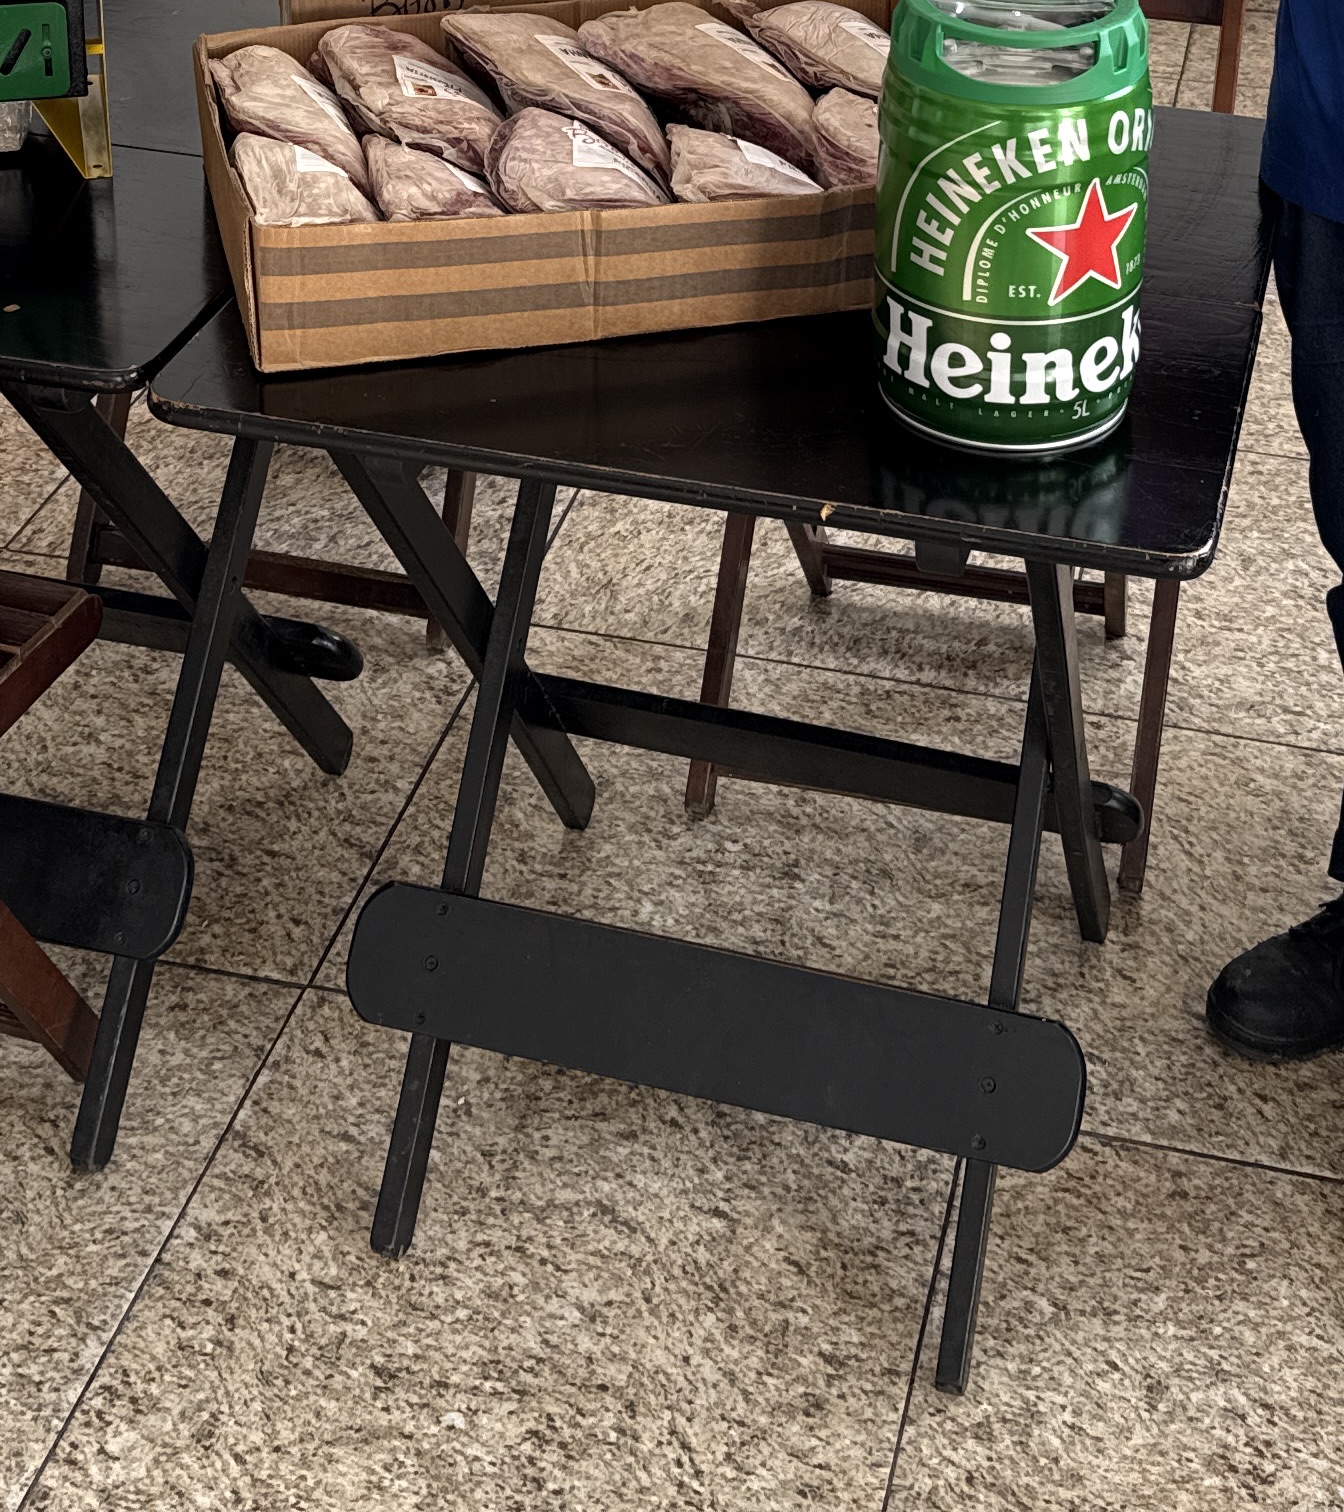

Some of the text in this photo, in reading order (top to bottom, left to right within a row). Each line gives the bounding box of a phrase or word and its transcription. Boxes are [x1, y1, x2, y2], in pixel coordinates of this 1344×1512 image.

[909, 117, 1091, 277] HEINEKEN
[975, 182, 1083, 304] DIPLOME D'HONNEUR
[1008, 284, 1042, 298] EST.
